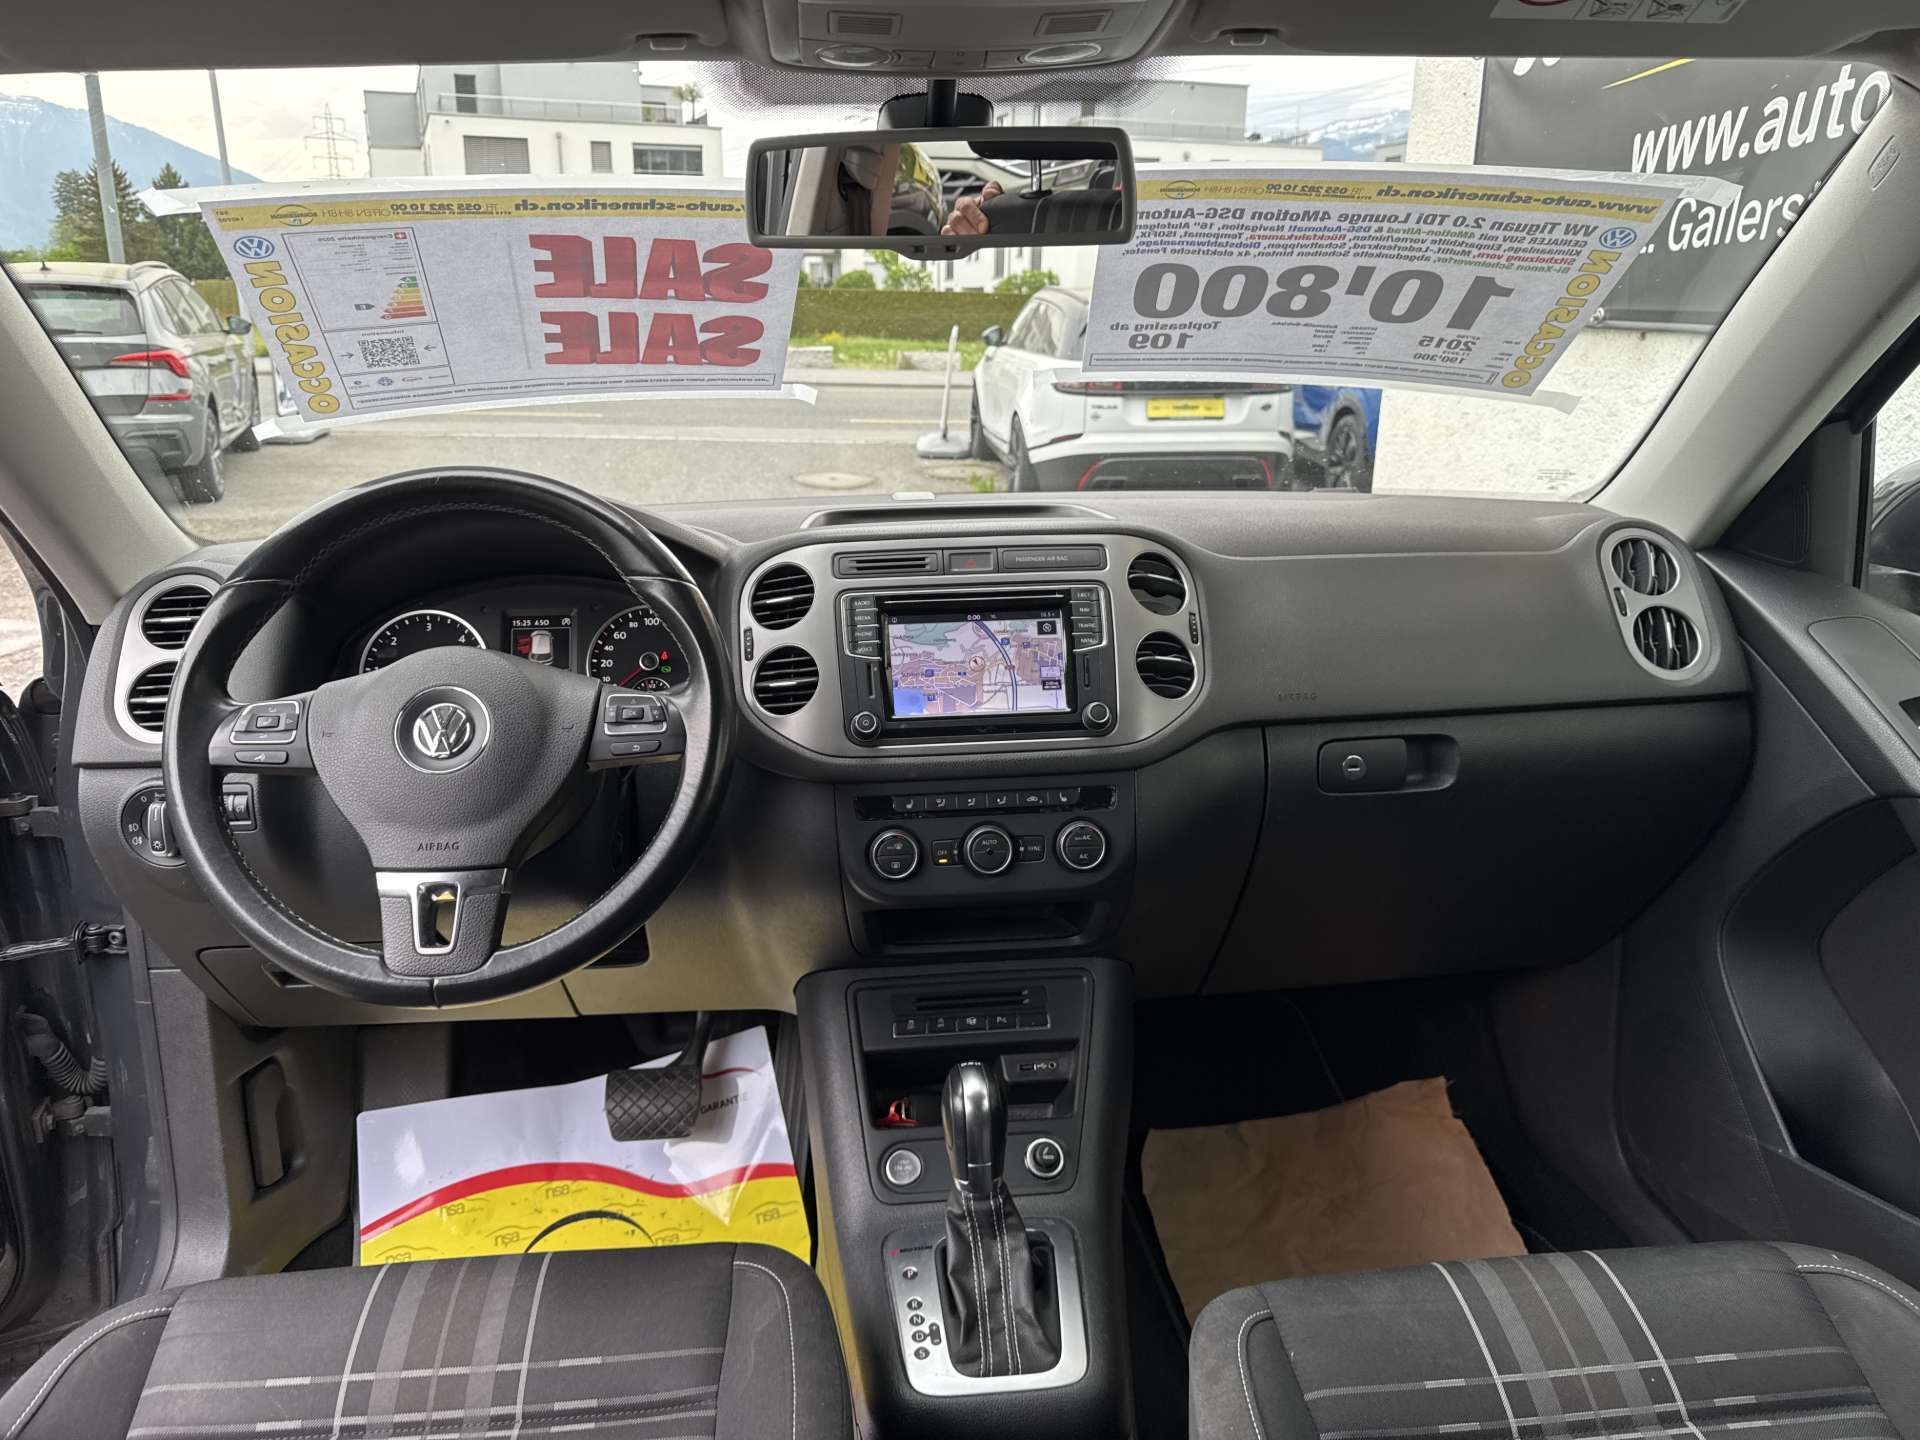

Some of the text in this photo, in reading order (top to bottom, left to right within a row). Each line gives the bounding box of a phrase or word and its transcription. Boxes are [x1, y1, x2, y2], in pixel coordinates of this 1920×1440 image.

[1668, 182, 1822, 253] Gallers
[644, 617, 661, 627] 100
[967, 613, 981, 621] 0:00
[425, 622, 432, 632] 3
[512, 619, 532, 627] 15:25
[629, 621, 639, 629] 80
[389, 636, 398, 646] 2
[458, 634, 467, 644] 4
[613, 631, 627, 641] 60
[603, 644, 615, 654] 40
[600, 660, 614, 669] 20
[602, 675, 612, 683] 10
[417, 841, 461, 852] AIRBAG
[544, 1183, 571, 1200] nsa
[440, 1202, 466, 1218] nsa
[755, 1207, 781, 1225] nsa
[494, 1231, 520, 1247] nsa
[911, 1299, 919, 1309] R
[913, 1315, 922, 1325] N
[916, 1332, 925, 1341] D
[917, 1348, 926, 1359] S
